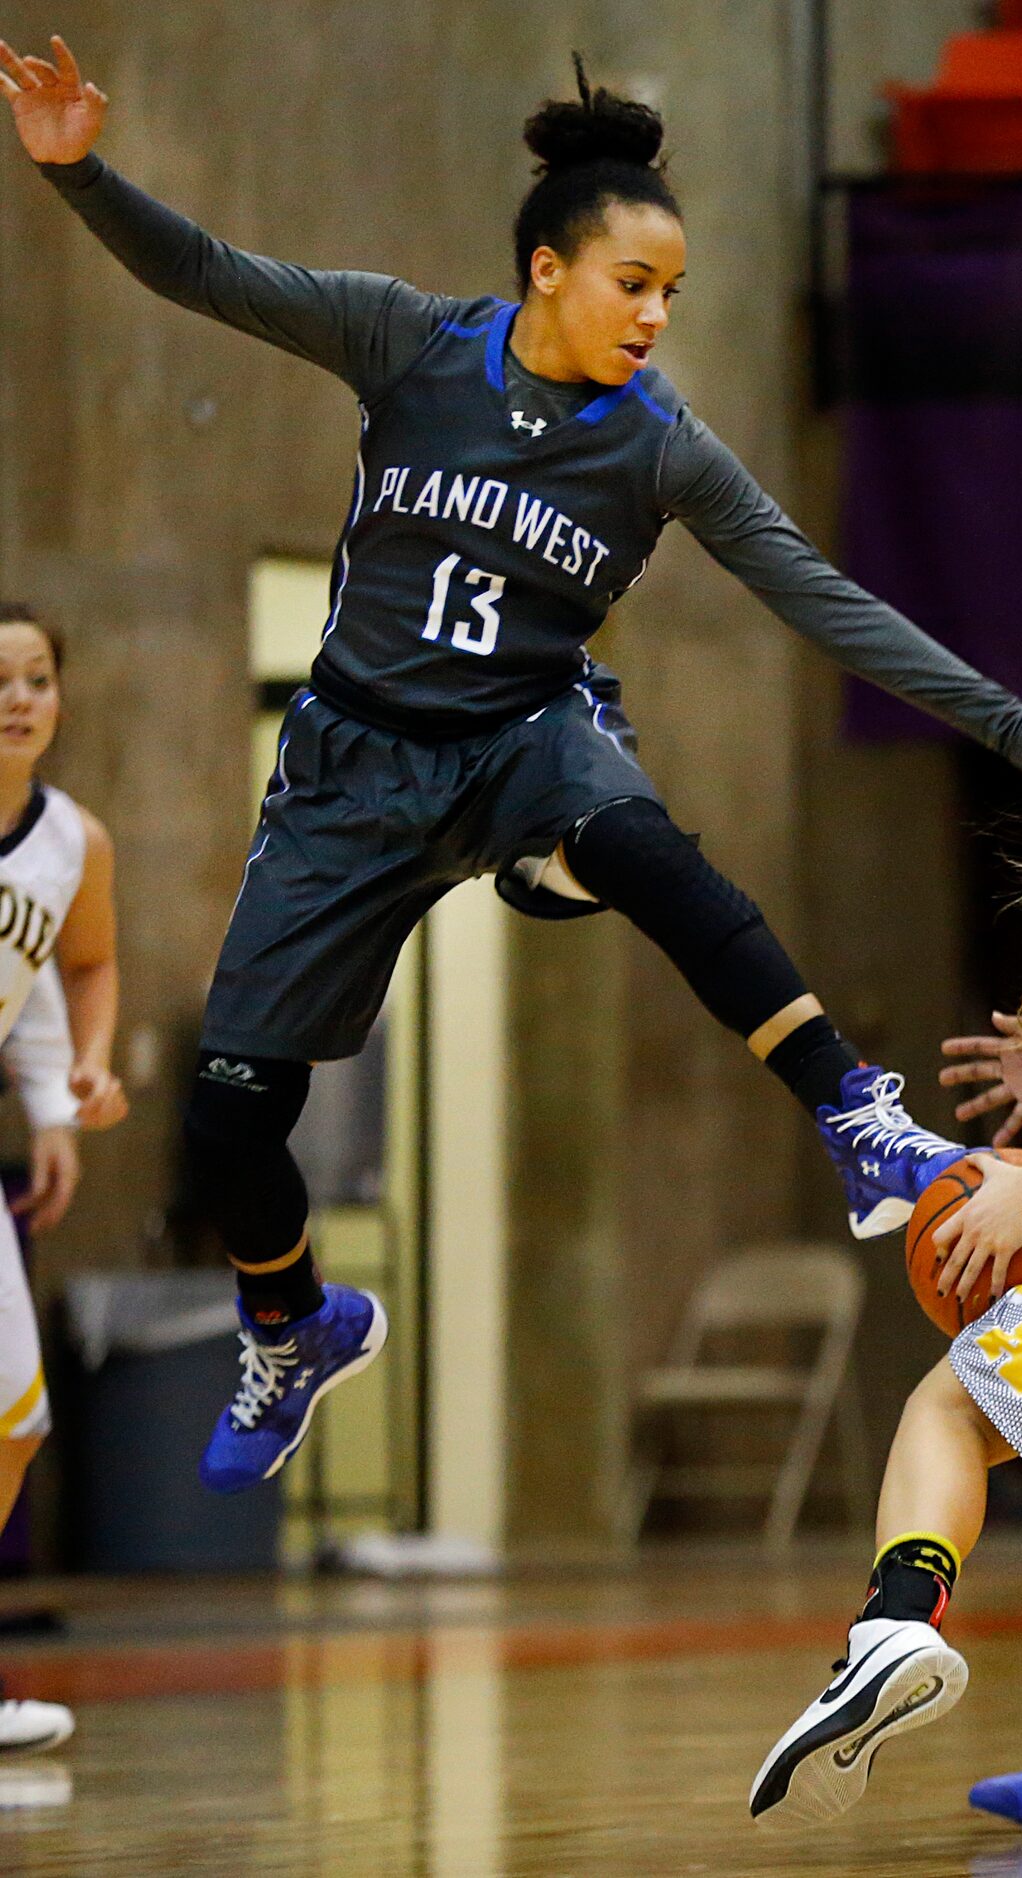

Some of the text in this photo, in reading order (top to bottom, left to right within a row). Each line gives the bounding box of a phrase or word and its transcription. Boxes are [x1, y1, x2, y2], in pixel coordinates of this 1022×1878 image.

[373, 466, 610, 586] PLANO WEST
[420, 552, 507, 656] 13
